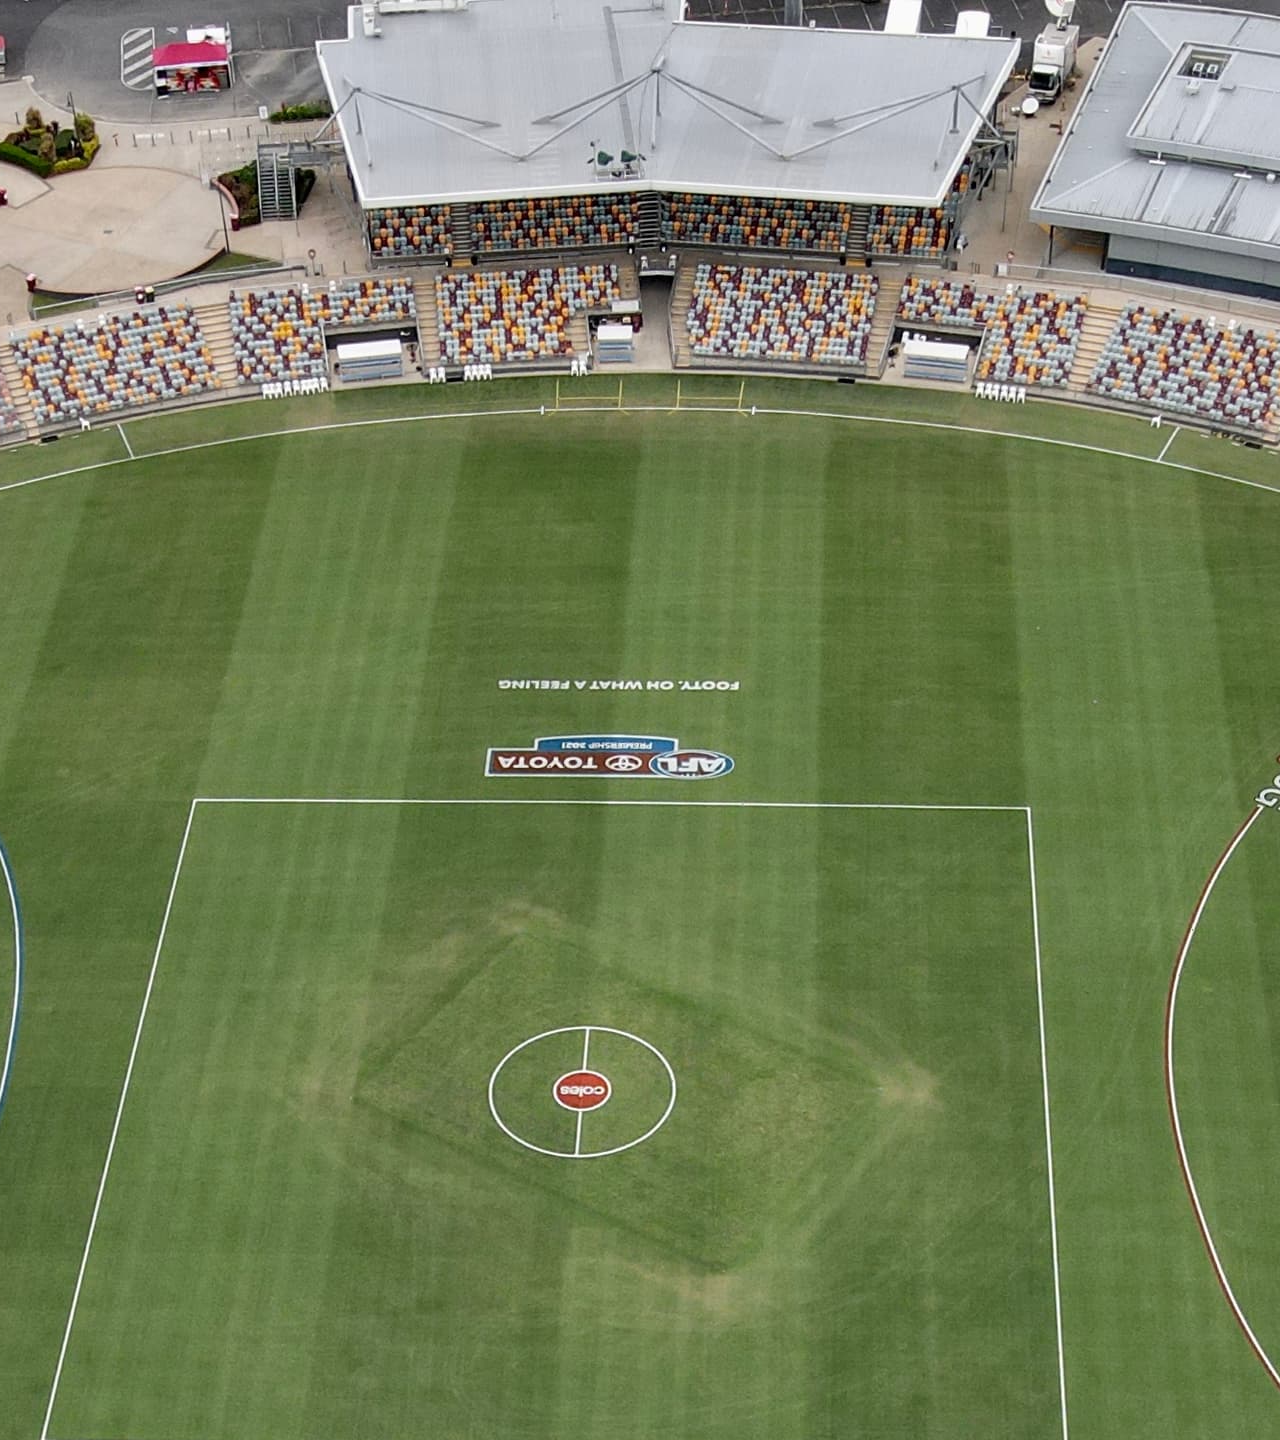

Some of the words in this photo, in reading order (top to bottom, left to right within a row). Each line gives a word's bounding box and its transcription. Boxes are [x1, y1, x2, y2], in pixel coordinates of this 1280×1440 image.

[498, 680, 570, 690] FEELING
[576, 680, 586, 690] A
[590, 680, 642, 690] WHAT
[646, 680, 674, 690] OH
[562, 741, 585, 750] 2021
[588, 741, 652, 750] PREMIERSHIP
[498, 756, 598, 769] TOYOTA
[660, 757, 726, 773] AFL
[560, 1085, 605, 1097] coles
